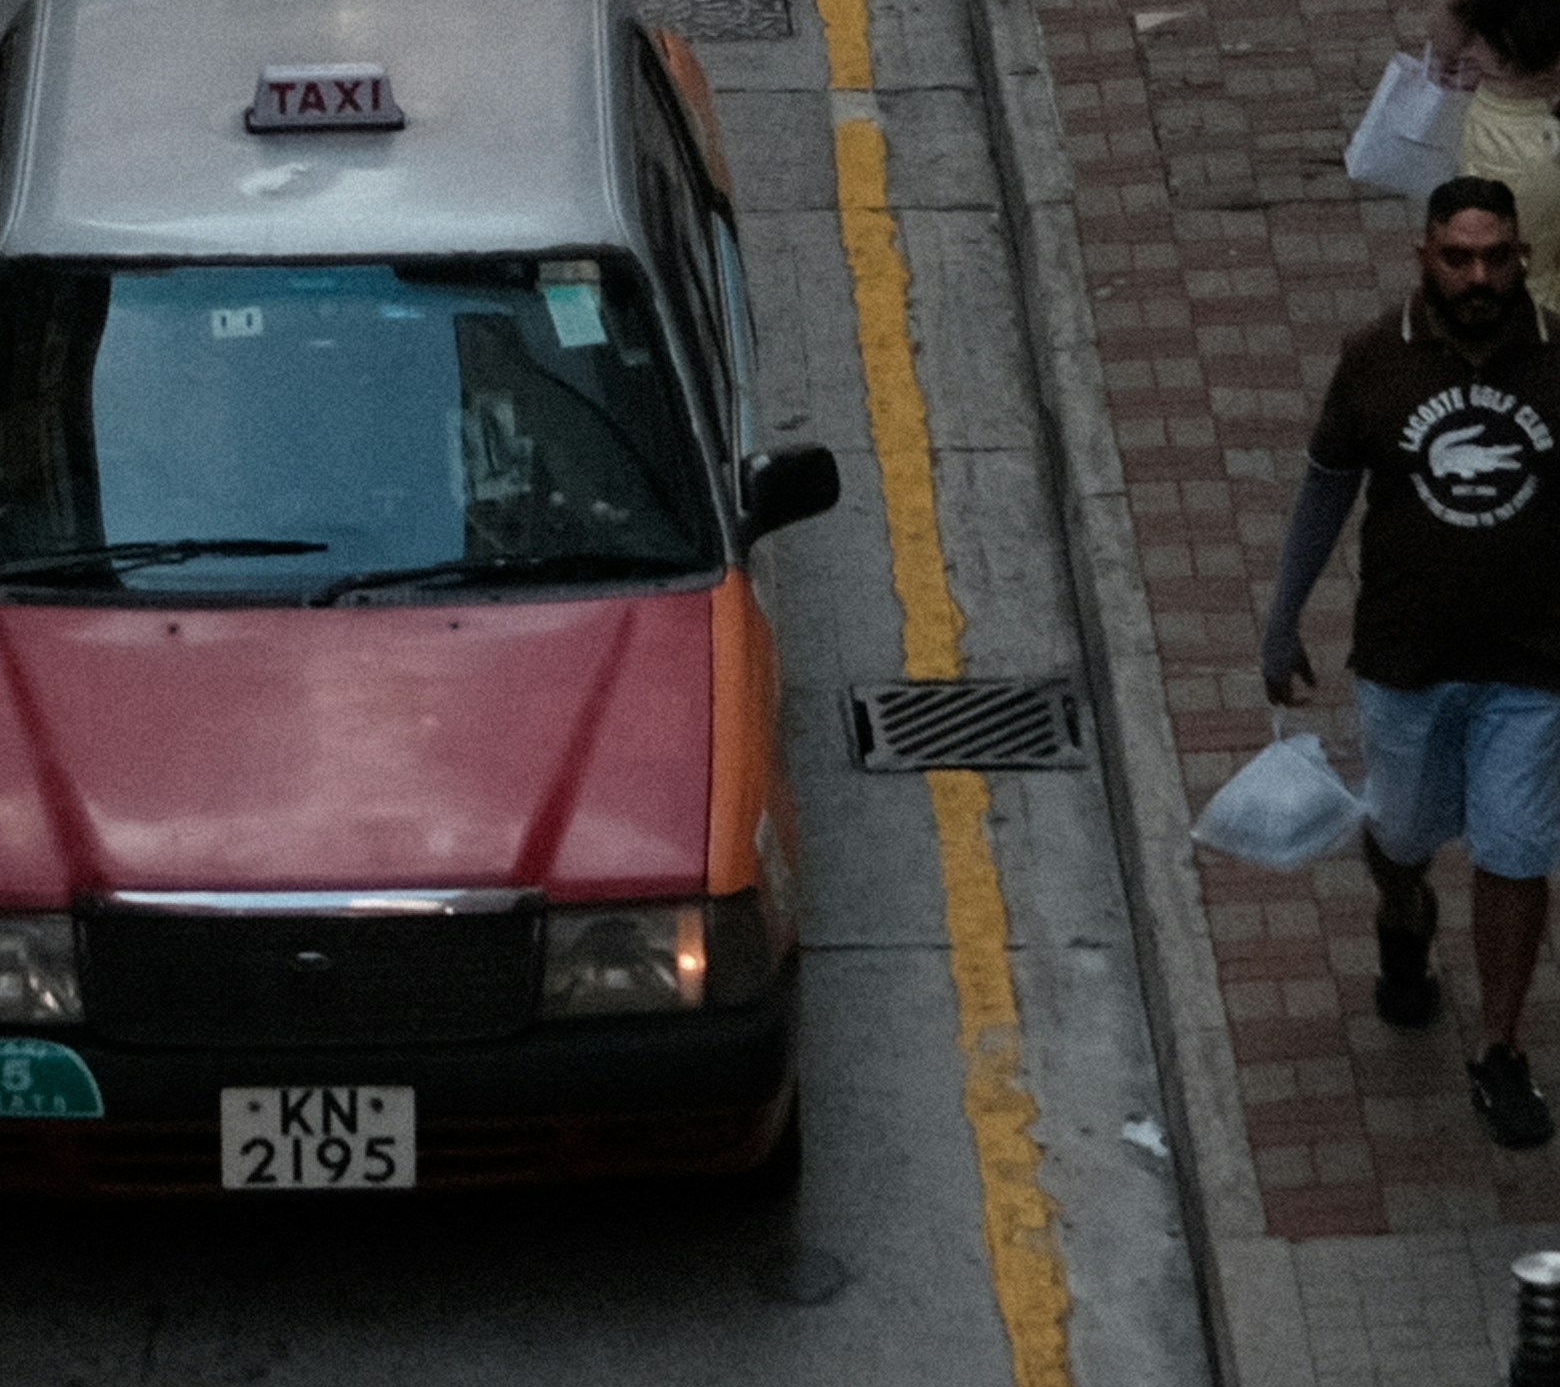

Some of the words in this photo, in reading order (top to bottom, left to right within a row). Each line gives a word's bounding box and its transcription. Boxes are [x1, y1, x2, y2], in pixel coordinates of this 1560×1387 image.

[268, 79, 383, 115] TAXI
[1398, 386, 1465, 451] LACOSTE
[1470, 384, 1516, 414] GOLF
[1515, 405, 1555, 453] CLUB
[2, 1059, 33, 1091] 5
[280, 1089, 358, 1136] KN
[240, 1137, 396, 1184] 2195
